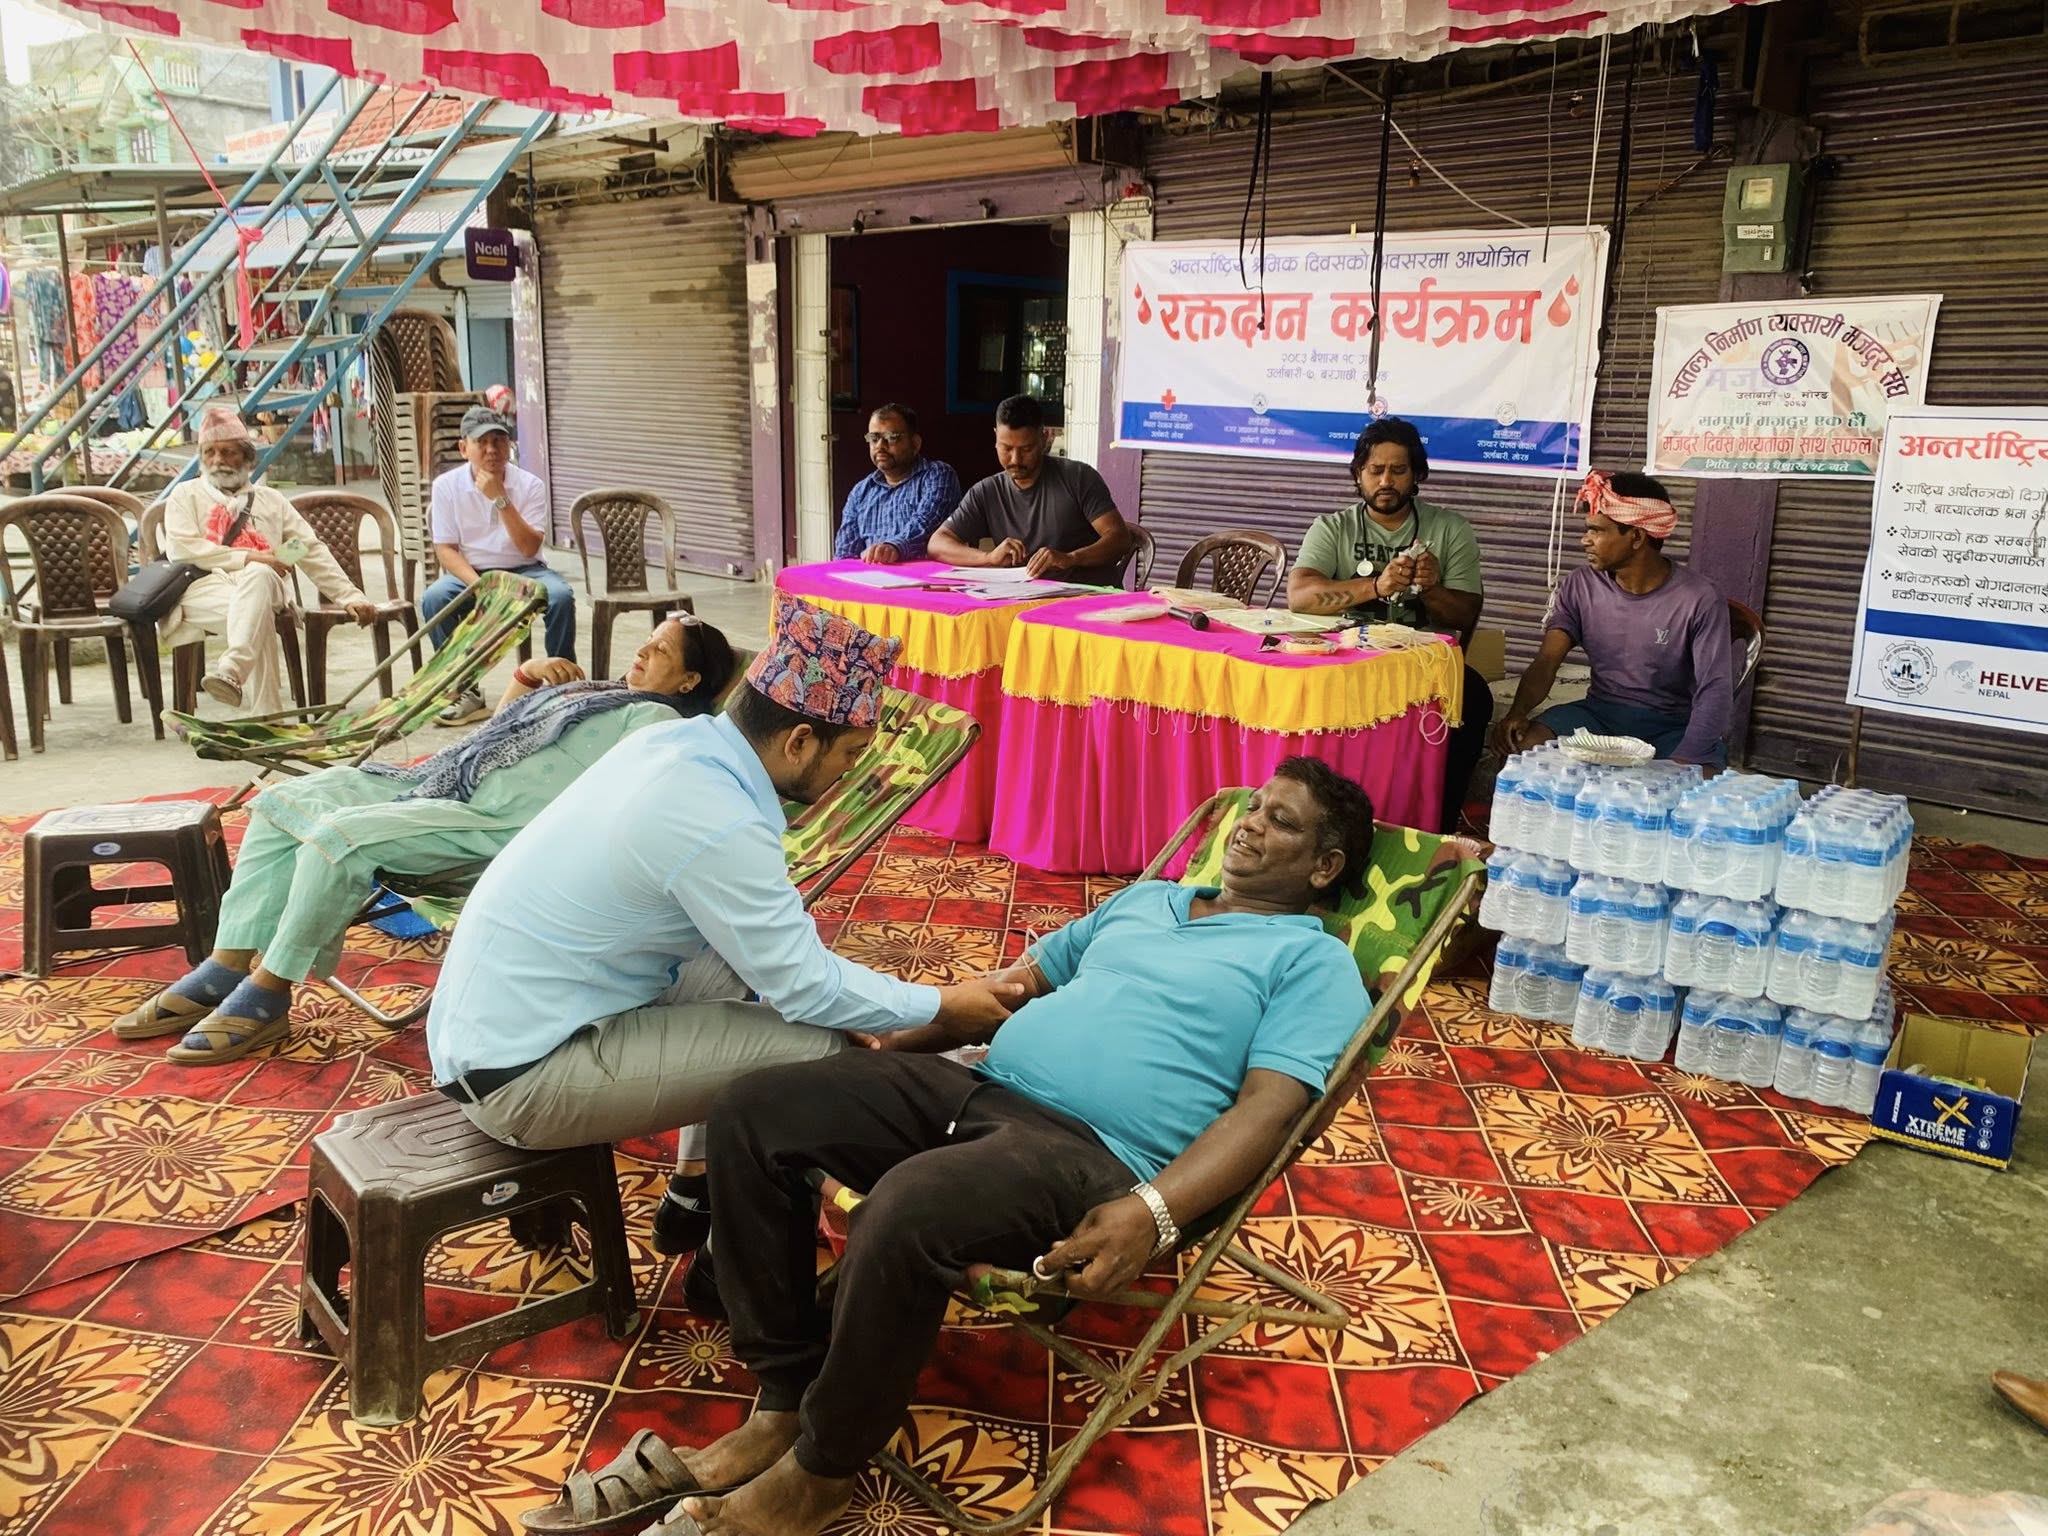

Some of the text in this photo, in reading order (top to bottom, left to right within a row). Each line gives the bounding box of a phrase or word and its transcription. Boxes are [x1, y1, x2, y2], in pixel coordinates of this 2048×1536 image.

[475, 241, 508, 257] Ncell
[1252, 252, 1299, 274] श्रमिक
[1304, 248, 1371, 272] दिवसको
[1456, 244, 1531, 269] आयोजित
[1158, 276, 1542, 349] रक्तदान कार्यक्रम
[1667, 347, 1713, 400] स्वतन्त्र
[1704, 318, 1763, 356] निर्माण
[1767, 313, 1846, 339] व्यवसायी
[1841, 325, 1895, 371] मजदुर
[1880, 366, 1910, 399] संघ
[1698, 412, 1751, 430] सम्पूर्ण
[1756, 415, 1808, 430] मजदुर
[1814, 415, 1842, 427] एक
[1662, 435, 1700, 456] मजदुर
[1703, 431, 1735, 454] दिवस
[1800, 435, 1827, 454] साथ
[1831, 435, 1873, 455] सफल
[1947, 482, 2016, 501] अर्थतन्त्रको
[1934, 502, 2001, 518] बाध्यात्मक
[2004, 506, 2028, 520] श्रम
[1899, 525, 1963, 543] रोजगारको
[1965, 532, 1991, 545] हक
[1897, 543, 1938, 559] सेवाको
[1891, 587, 1975, 608] एकीकरणलाई
[1977, 596, 2034, 613] संस्थागत
[1978, 688, 2011, 700] NEPAL
[1905, 1127, 1966, 1147] ENERGY DRINK
[1907, 1114, 1967, 1141] XTREME
